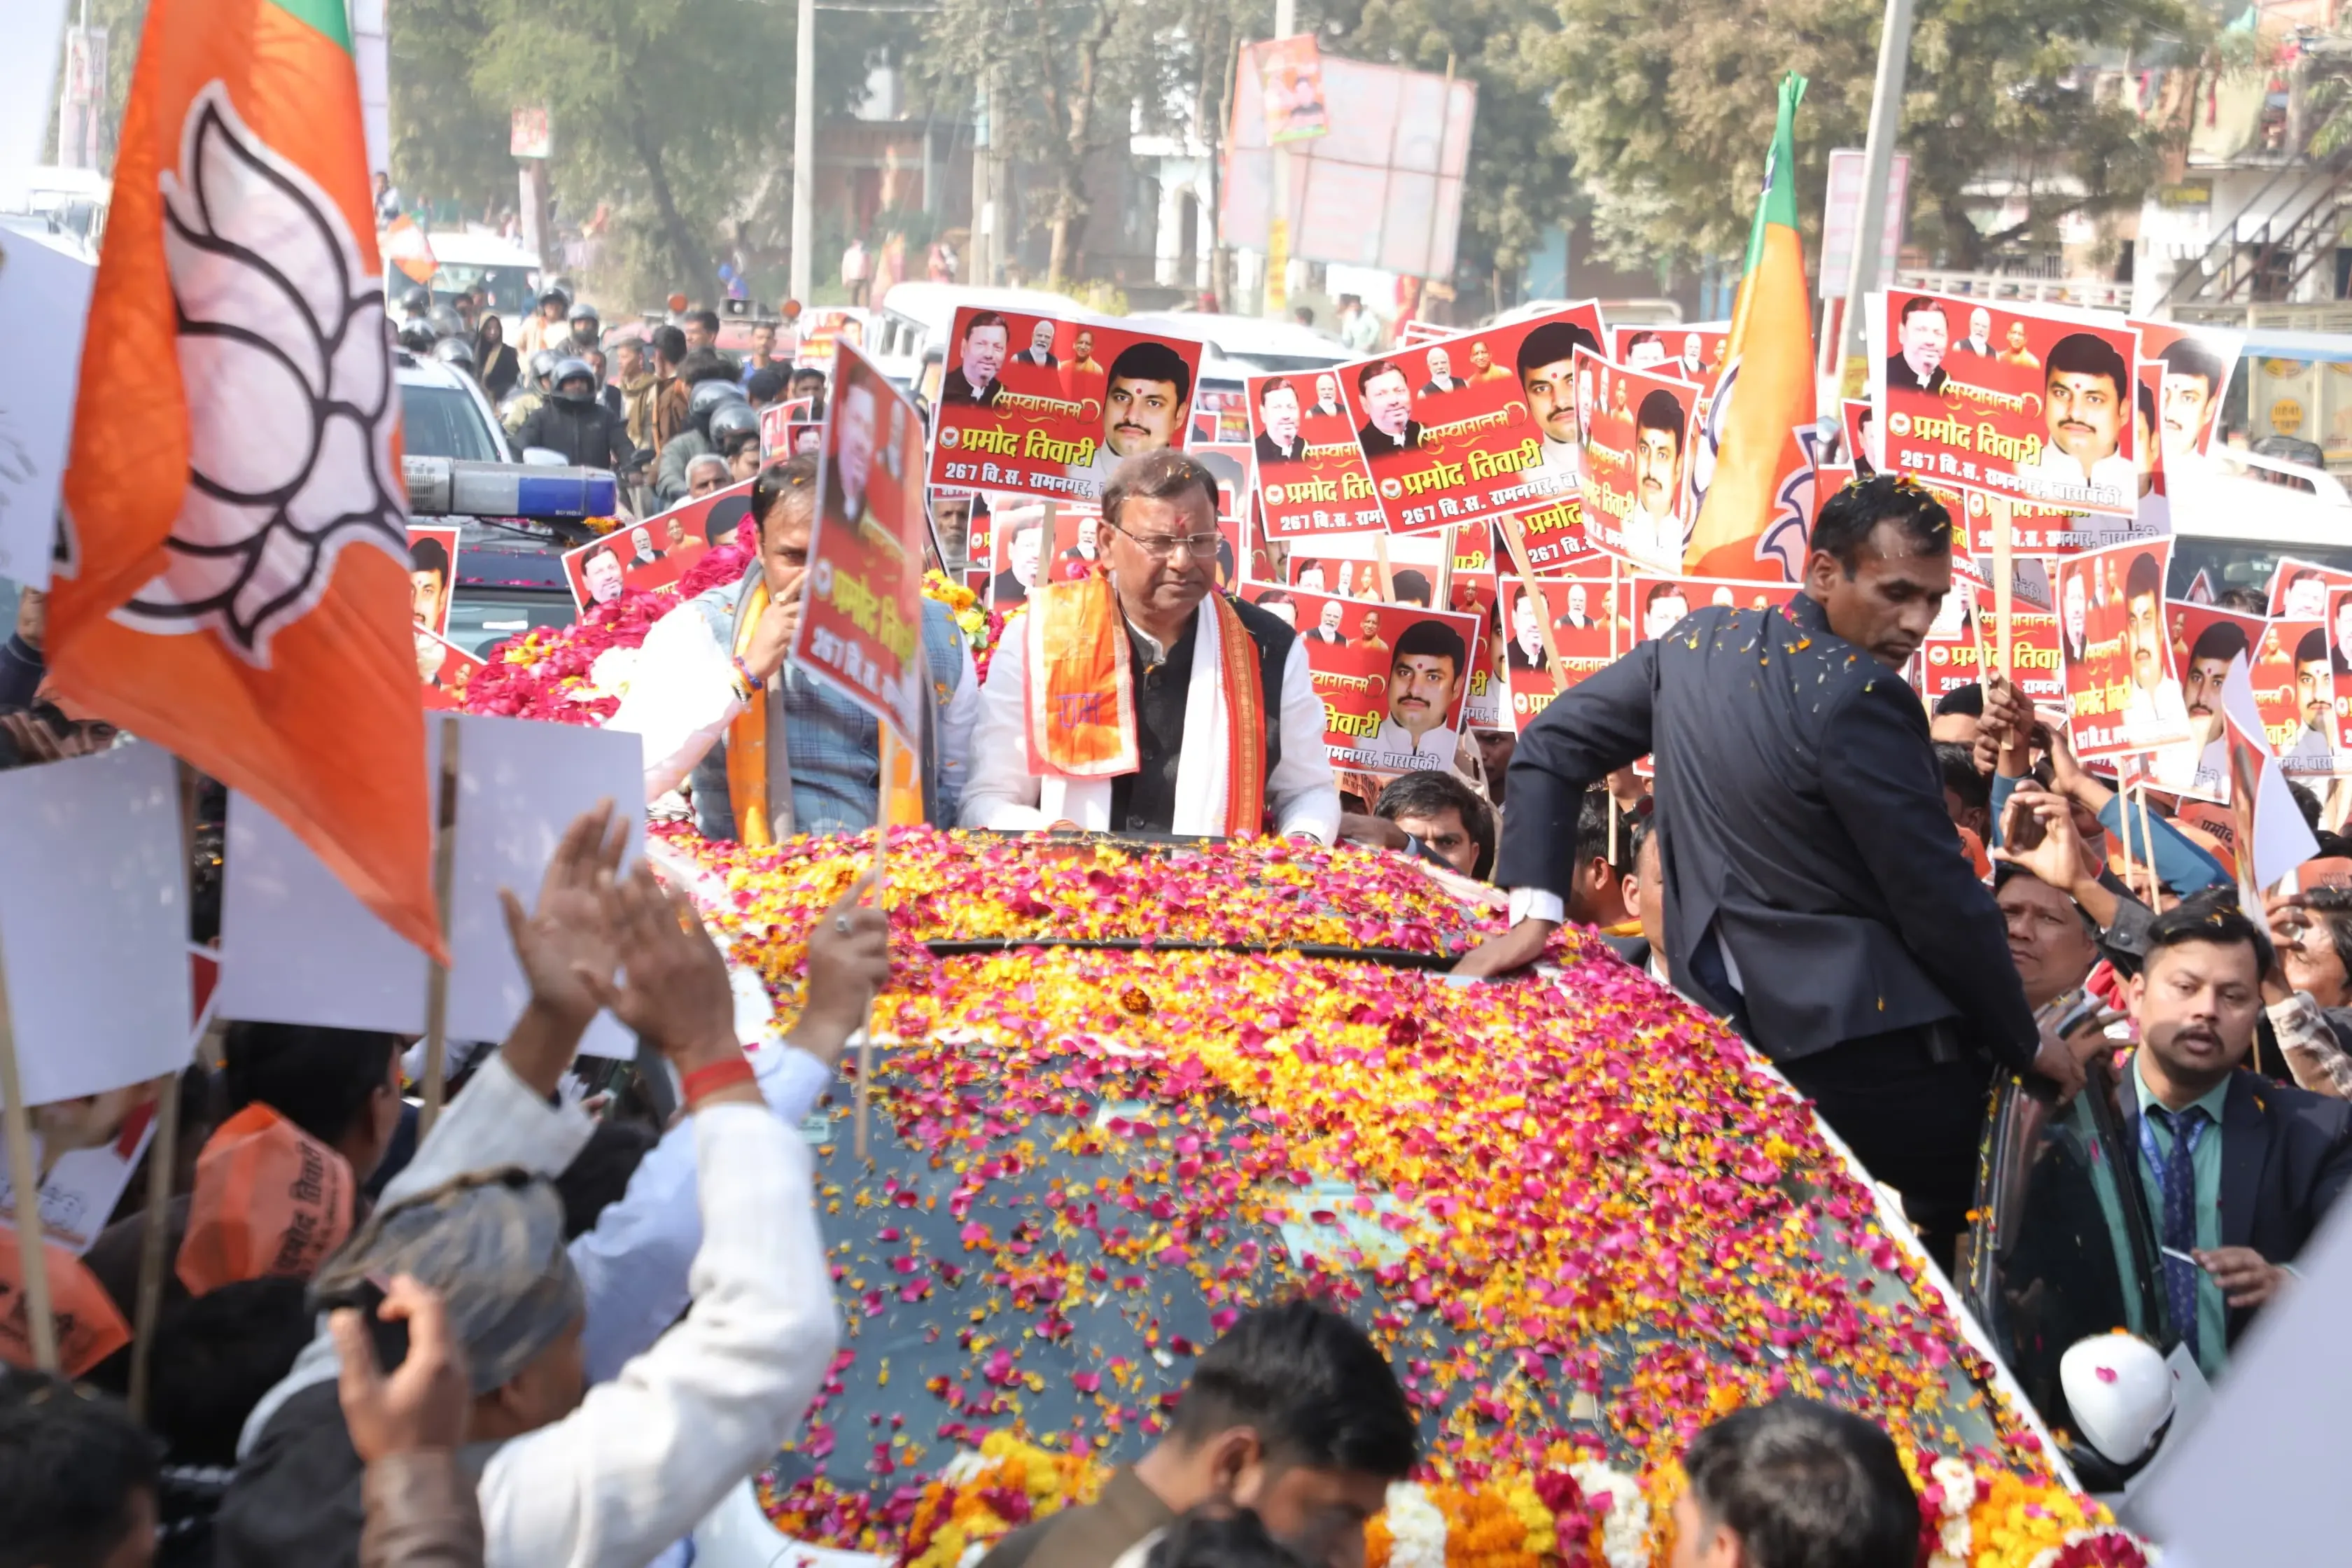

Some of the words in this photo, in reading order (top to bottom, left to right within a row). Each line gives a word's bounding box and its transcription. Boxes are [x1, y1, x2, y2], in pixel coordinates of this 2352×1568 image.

[962, 424, 1021, 458] प्रमोद
[1024, 428, 1097, 468] तिवारी
[1912, 413, 1973, 451] प्रमोद
[1977, 421, 2044, 466] तिवारी
[945, 461, 978, 481] 267
[981, 462, 1023, 486] वि.स.
[1029, 471, 1093, 500] रामनगर,
[1401, 460, 1466, 496] प्रमोद
[1468, 438, 1544, 482] तिवारी
[1900, 450, 1935, 470] 267
[1940, 452, 1981, 482] वि.स.
[1985, 468, 2047, 500] रामनगर,
[2052, 479, 2122, 506] बाराबंकी
[1285, 475, 1338, 504] प्रमोद
[1341, 472, 1376, 500] तिव
[1401, 505, 1436, 526] 267
[1438, 495, 1487, 519] वि.स.
[1488, 477, 1559, 506] रामनगर,
[1280, 514, 1310, 531] 267
[1312, 510, 1352, 530] वि.स.
[1524, 502, 1583, 536] प्रमोद
[1527, 543, 1559, 563] 267
[810, 625, 846, 669] 267
[2013, 641, 2062, 669] तिवा
[2022, 680, 2064, 694] रामन
[1056, 692, 1102, 728] राम
[2263, 718, 2298, 746] वारी
[1324, 745, 1379, 768] ामनगर,
[1383, 750, 1441, 771] बाराबंकी
